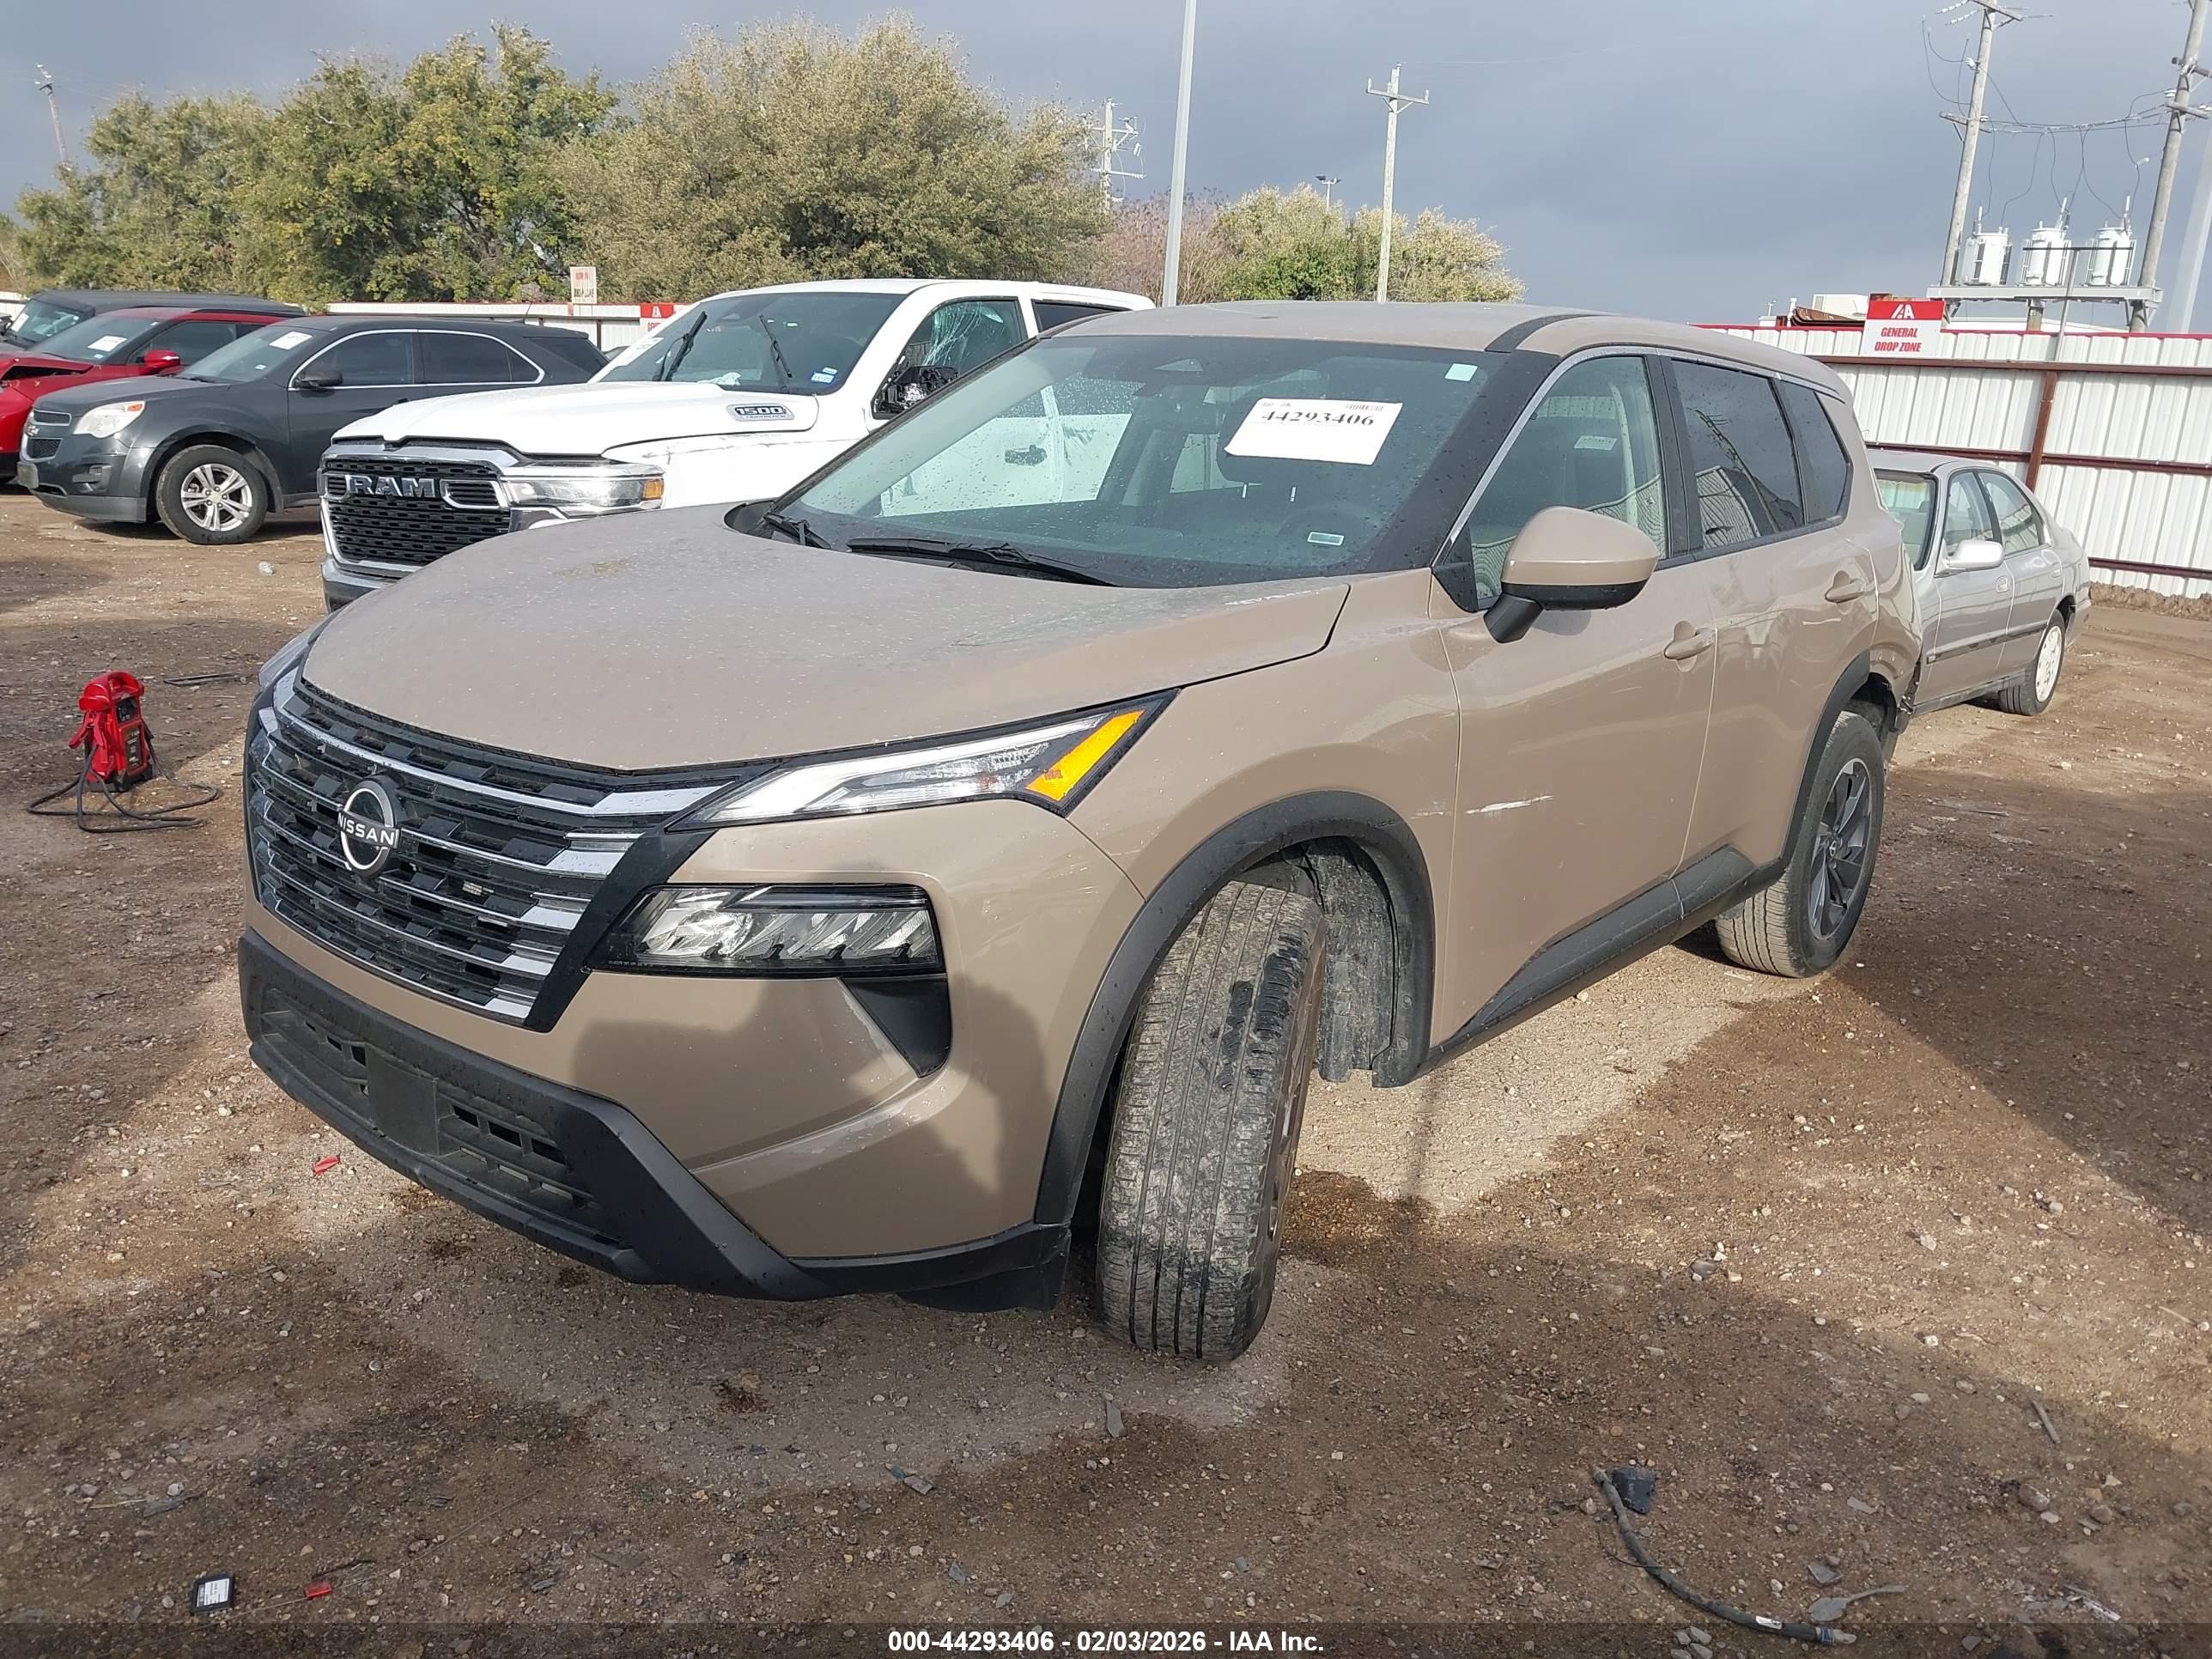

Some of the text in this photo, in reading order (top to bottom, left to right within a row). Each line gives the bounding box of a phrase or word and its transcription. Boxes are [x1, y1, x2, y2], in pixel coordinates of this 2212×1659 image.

[1881, 326, 1918, 337] GENERAL
[1874, 341, 1923, 352] DROP ZONE
[734, 405, 784, 416] 1500
[1261, 410, 1375, 426] 44293406
[345, 474, 436, 498] RAM
[337, 811, 395, 846] NISSAN
